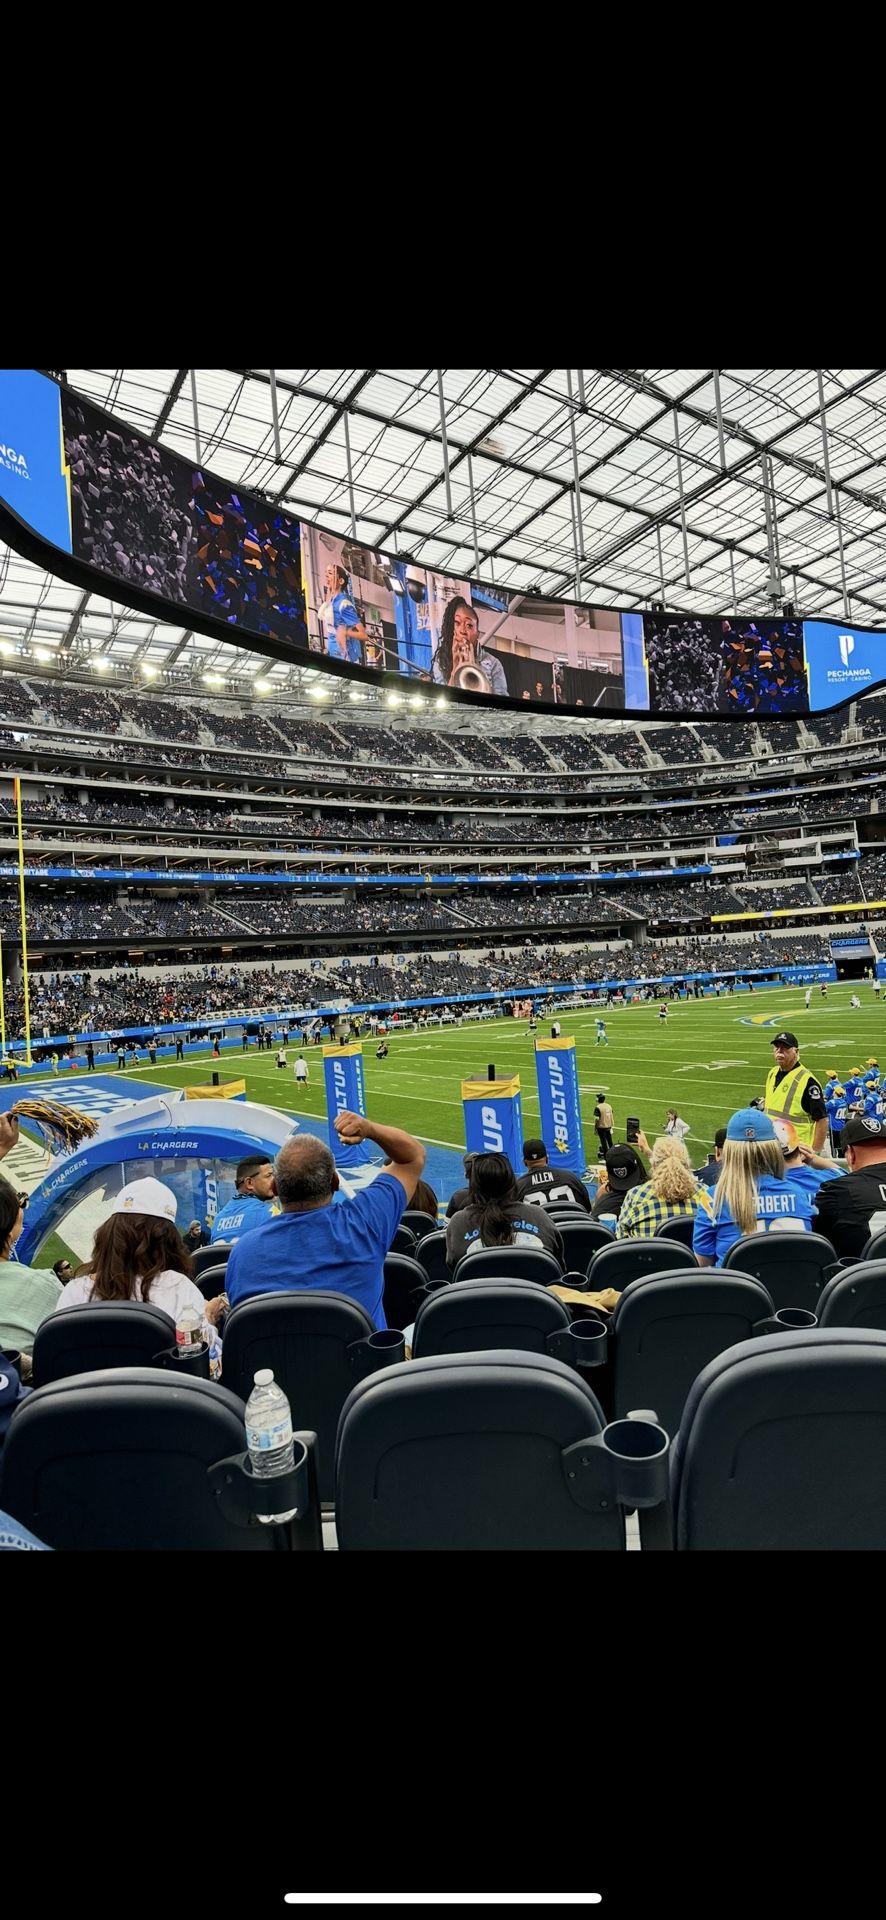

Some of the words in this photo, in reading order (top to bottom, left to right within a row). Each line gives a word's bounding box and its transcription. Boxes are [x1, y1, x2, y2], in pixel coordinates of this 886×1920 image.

[827, 669, 871, 677] PECHANGA
[14, 868, 48, 876] HRITAGE
[831, 938, 869, 947] CHARGERS
[333, 1061, 348, 1116] LTUP
[547, 1055, 570, 1153] #BOLTUP
[139, 1142, 150, 1151] LA
[151, 1141, 199, 1150] CHARGERS
[51, 1158, 89, 1190] CHARGERS
[531, 1172, 554, 1186] ALLEN
[217, 1213, 245, 1232] EKELER
